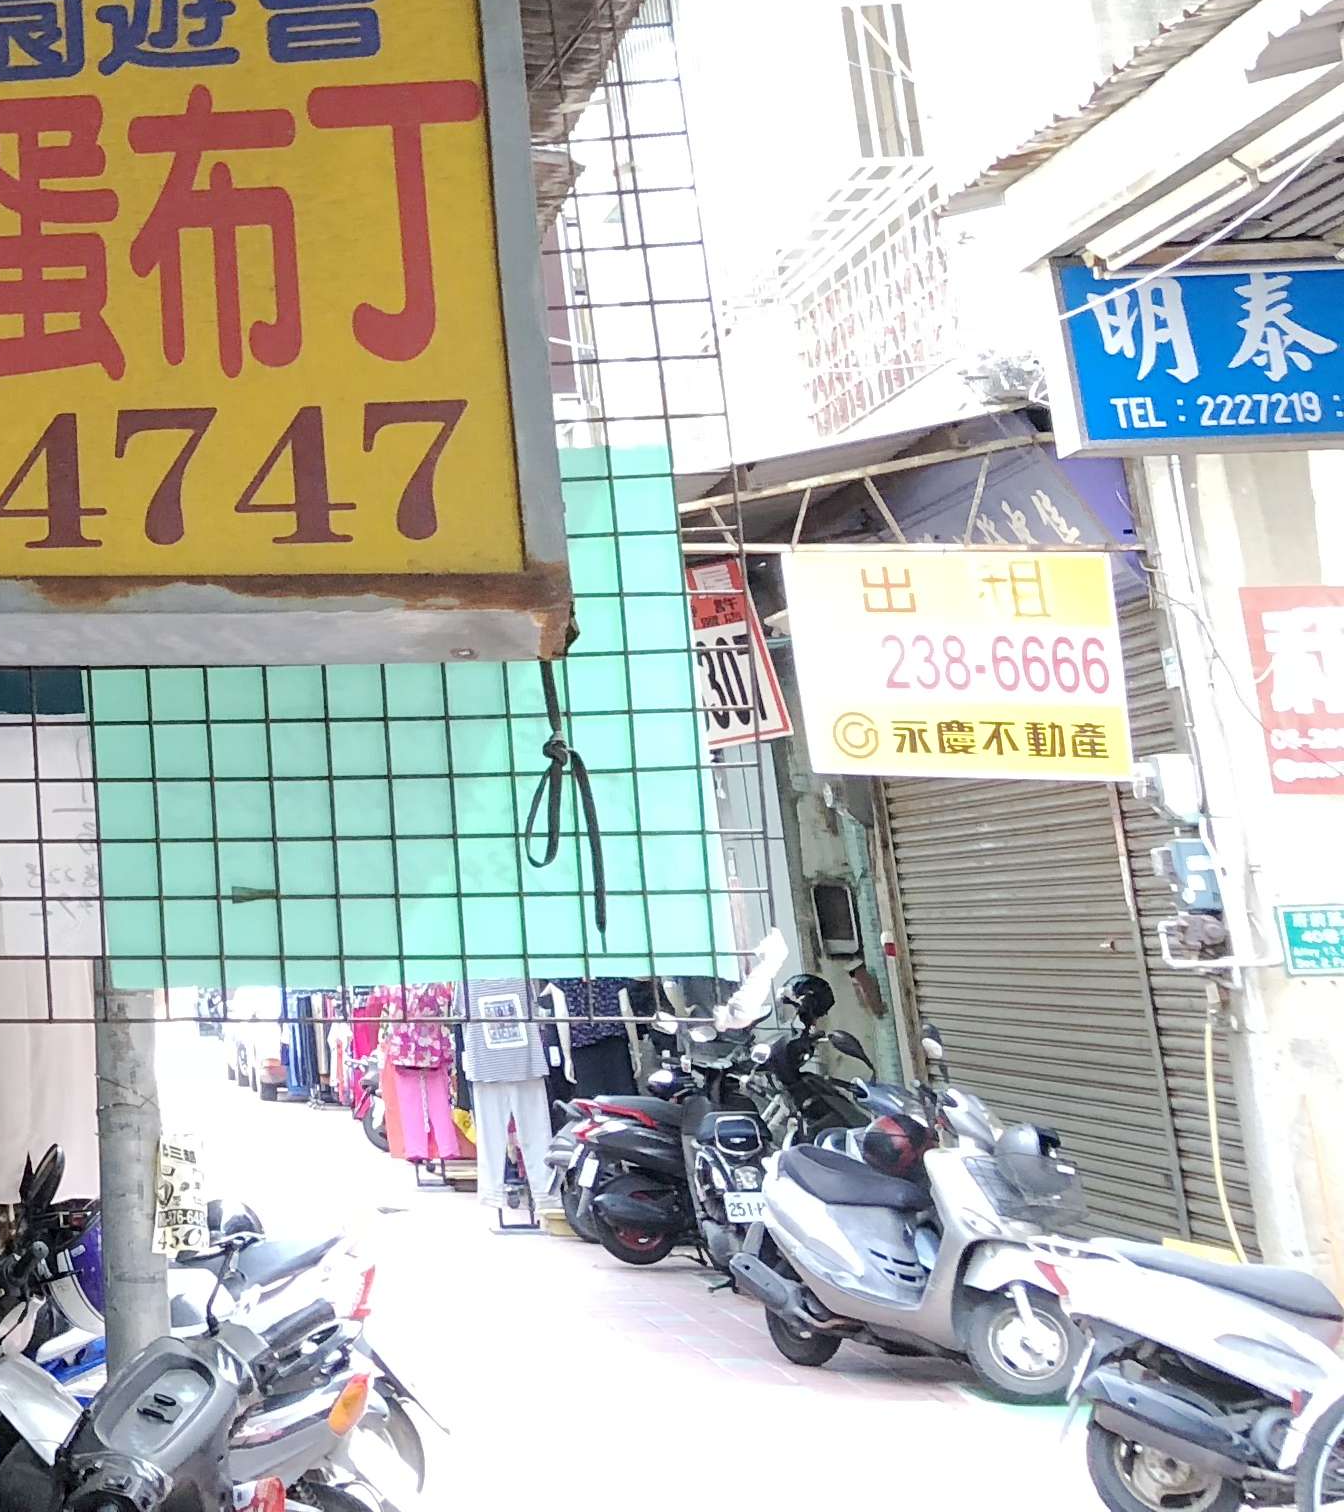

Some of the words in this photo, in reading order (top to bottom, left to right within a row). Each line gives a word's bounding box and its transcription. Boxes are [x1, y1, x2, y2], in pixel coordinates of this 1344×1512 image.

[1086, 273, 1338, 384] 明泰
[695, 634, 768, 732] 307
[881, 634, 1110, 694] 238-6666
[891, 719, 1110, 759] 永慶不動產
